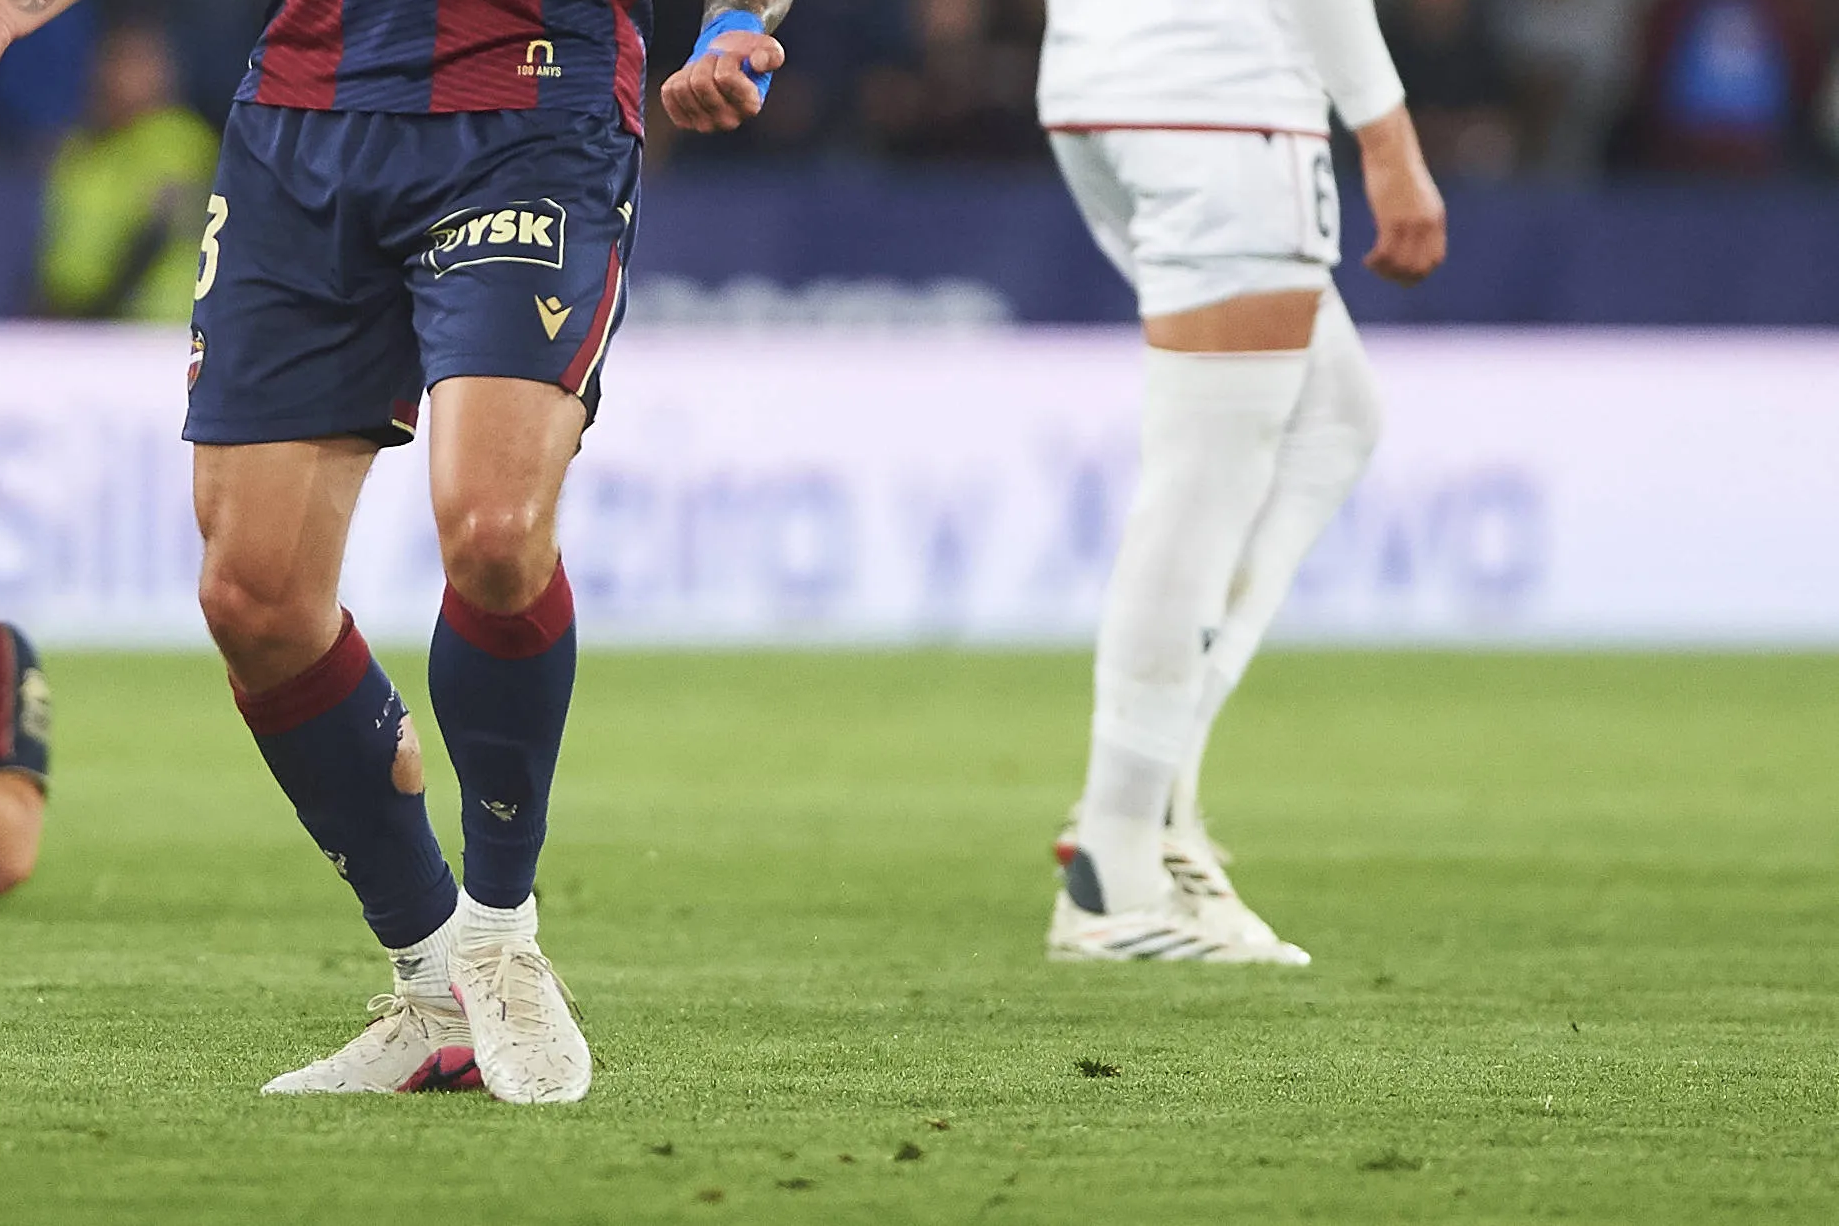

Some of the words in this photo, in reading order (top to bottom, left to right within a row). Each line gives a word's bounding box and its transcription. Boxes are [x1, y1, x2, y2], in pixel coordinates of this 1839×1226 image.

[517, 64, 534, 76] 100
[536, 65, 562, 78] ANYS
[441, 208, 555, 253] JYSK
